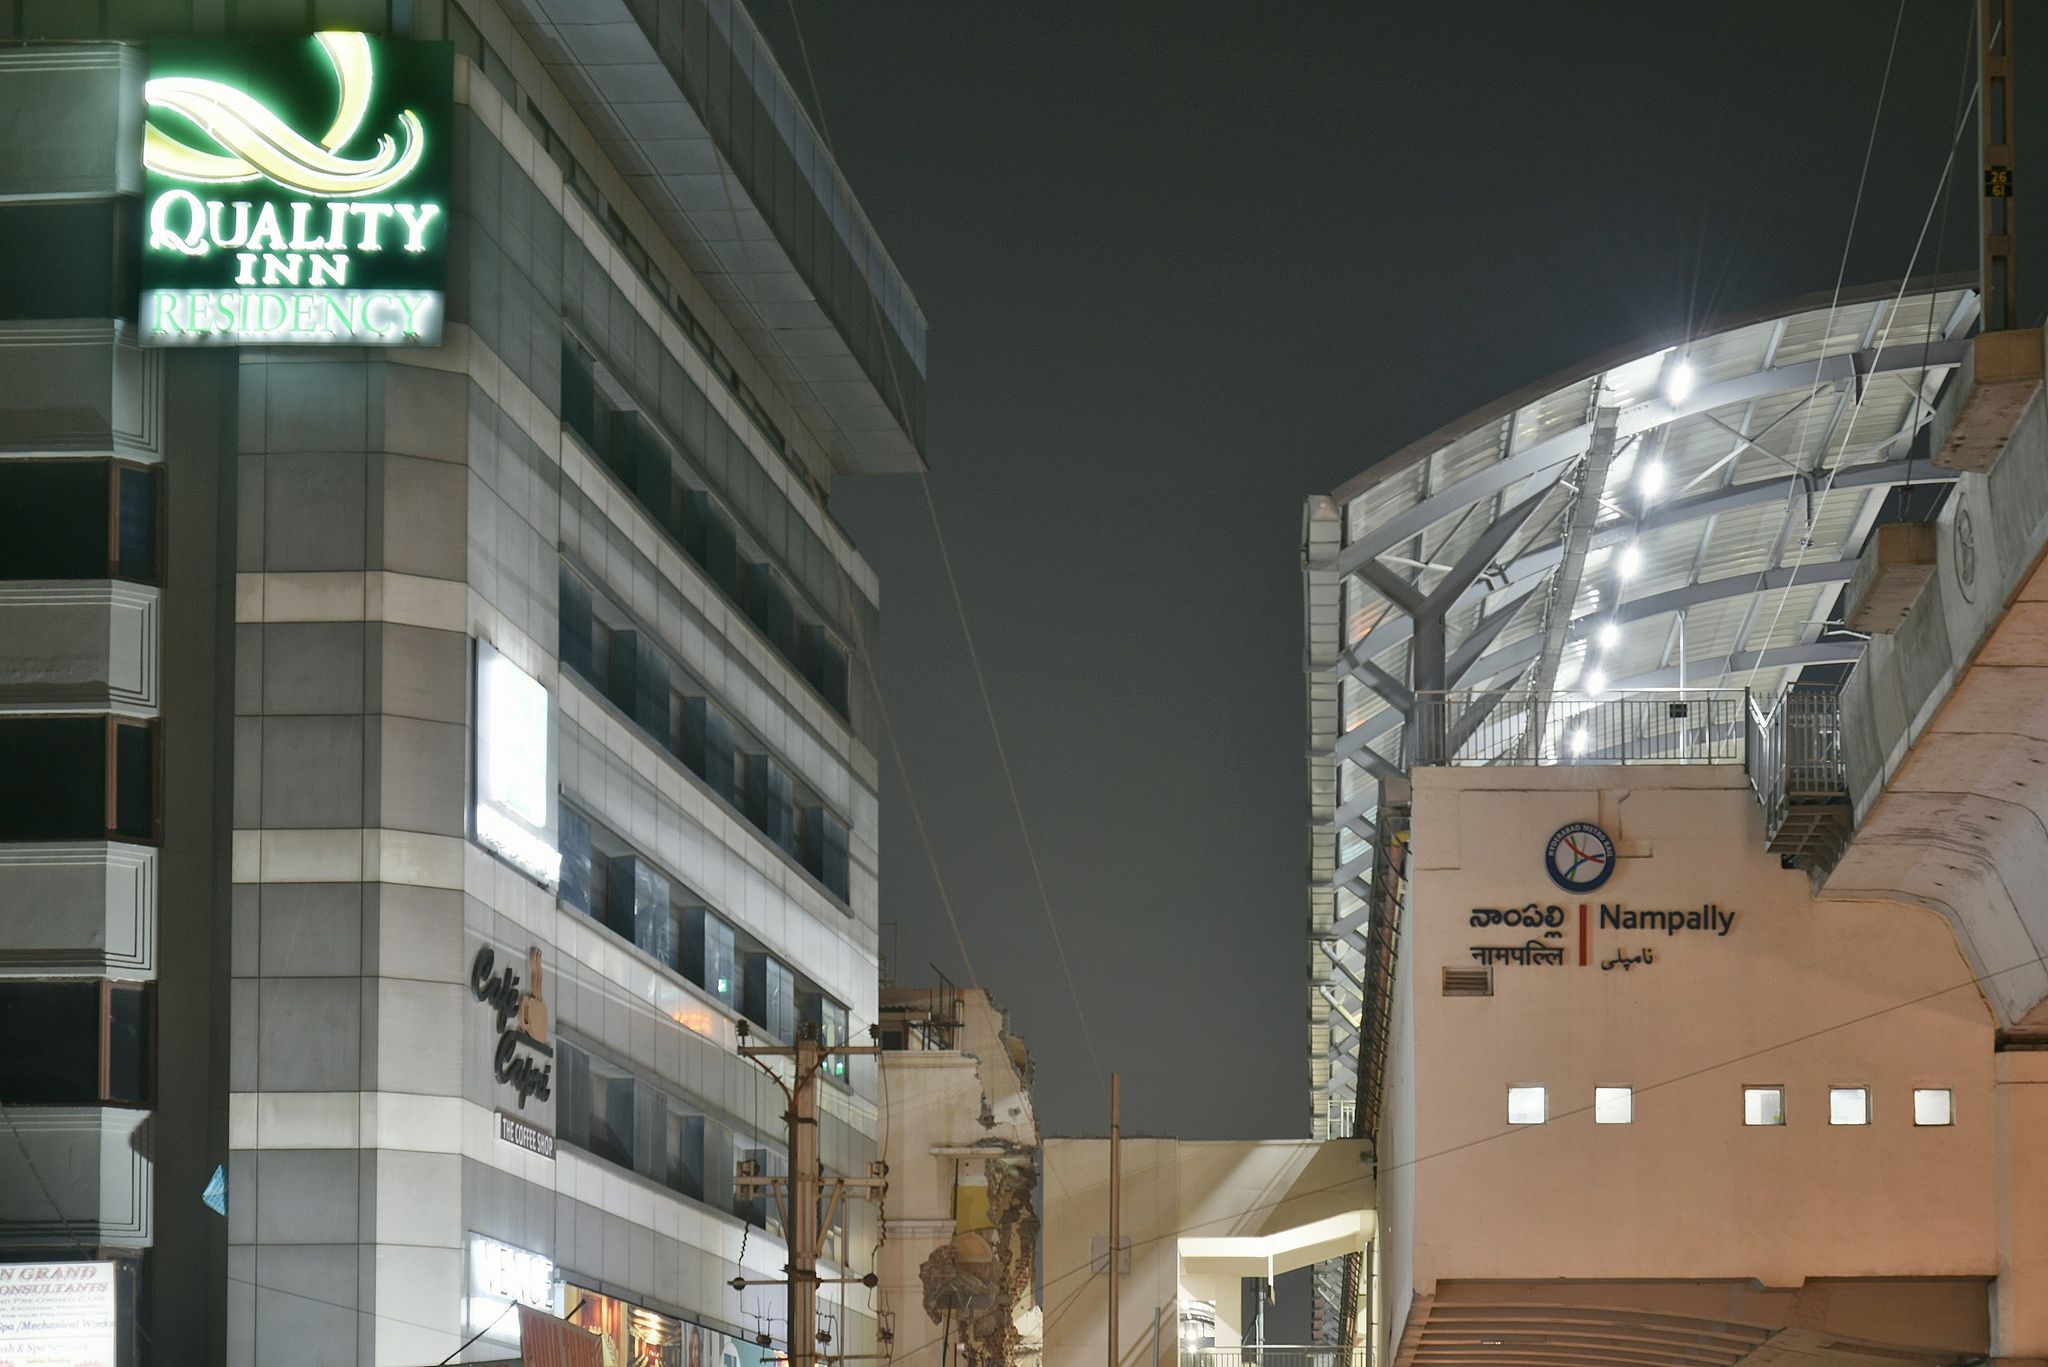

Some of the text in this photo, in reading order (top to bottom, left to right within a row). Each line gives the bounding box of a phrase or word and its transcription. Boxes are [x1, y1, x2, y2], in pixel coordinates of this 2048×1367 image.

[1991, 171, 2008, 184] 26
[149, 189, 440, 256] QUALITY
[234, 253, 350, 286] INN
[152, 290, 434, 337] RESIDENCY
[1547, 824, 1614, 857] HYDERABAD METRO RAIL
[1469, 904, 1565, 938] నాంపల్లి
[1600, 904, 1736, 936] Nampally
[1470, 940, 1565, 966] नामपल्लि
[494, 1028, 553, 1110] Capri
[502, 1118, 553, 1157] THE COFFEE SHOP
[19, 1266, 97, 1280] GRAND
